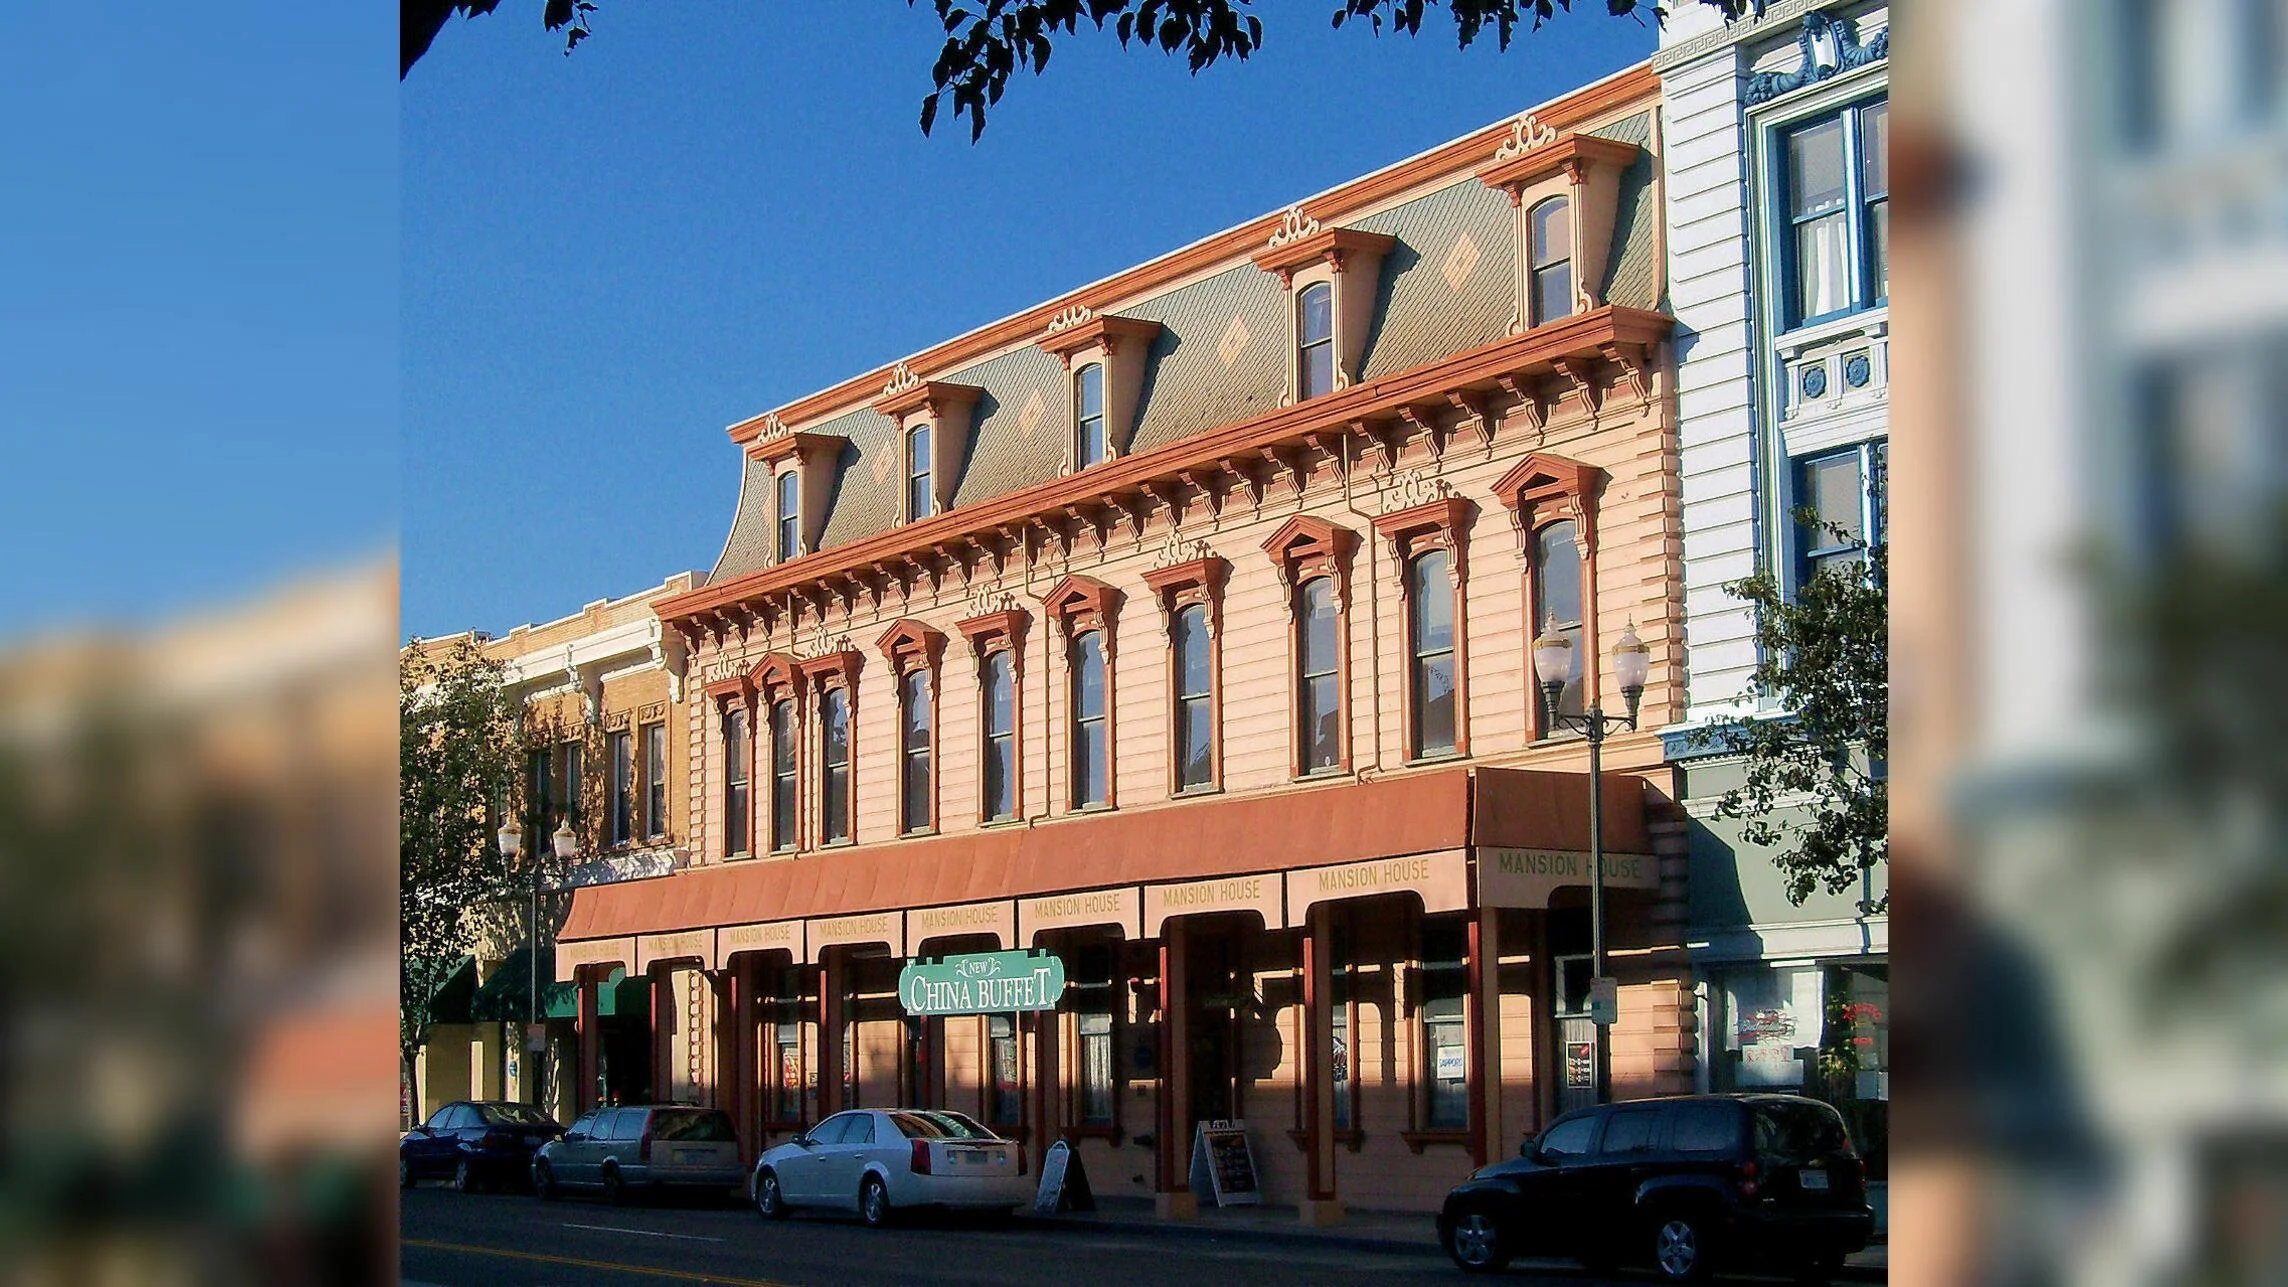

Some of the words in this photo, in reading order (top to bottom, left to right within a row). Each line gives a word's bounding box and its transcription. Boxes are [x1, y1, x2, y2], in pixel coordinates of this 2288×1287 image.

[1319, 866, 1378, 891] MANSION
[1384, 859, 1430, 884] HOUSE
[1499, 852, 1578, 877] MANSION
[1035, 899, 1080, 918] MANSION
[1085, 893, 1120, 913] HOUSE
[1164, 885, 1215, 908] MANSION
[1221, 879, 1260, 901] HOUSE
[820, 920, 857, 936] MANSION
[861, 916, 888, 933] HOUSE
[922, 911, 962, 928] MANSION
[966, 906, 998, 925] HOUSE
[730, 927, 762, 943] MANSION
[764, 924, 790, 940] HOUSE
[969, 961, 988, 975] NEW
[911, 975, 973, 1012] CHINA
[977, 967, 1052, 1009] BUFFET
